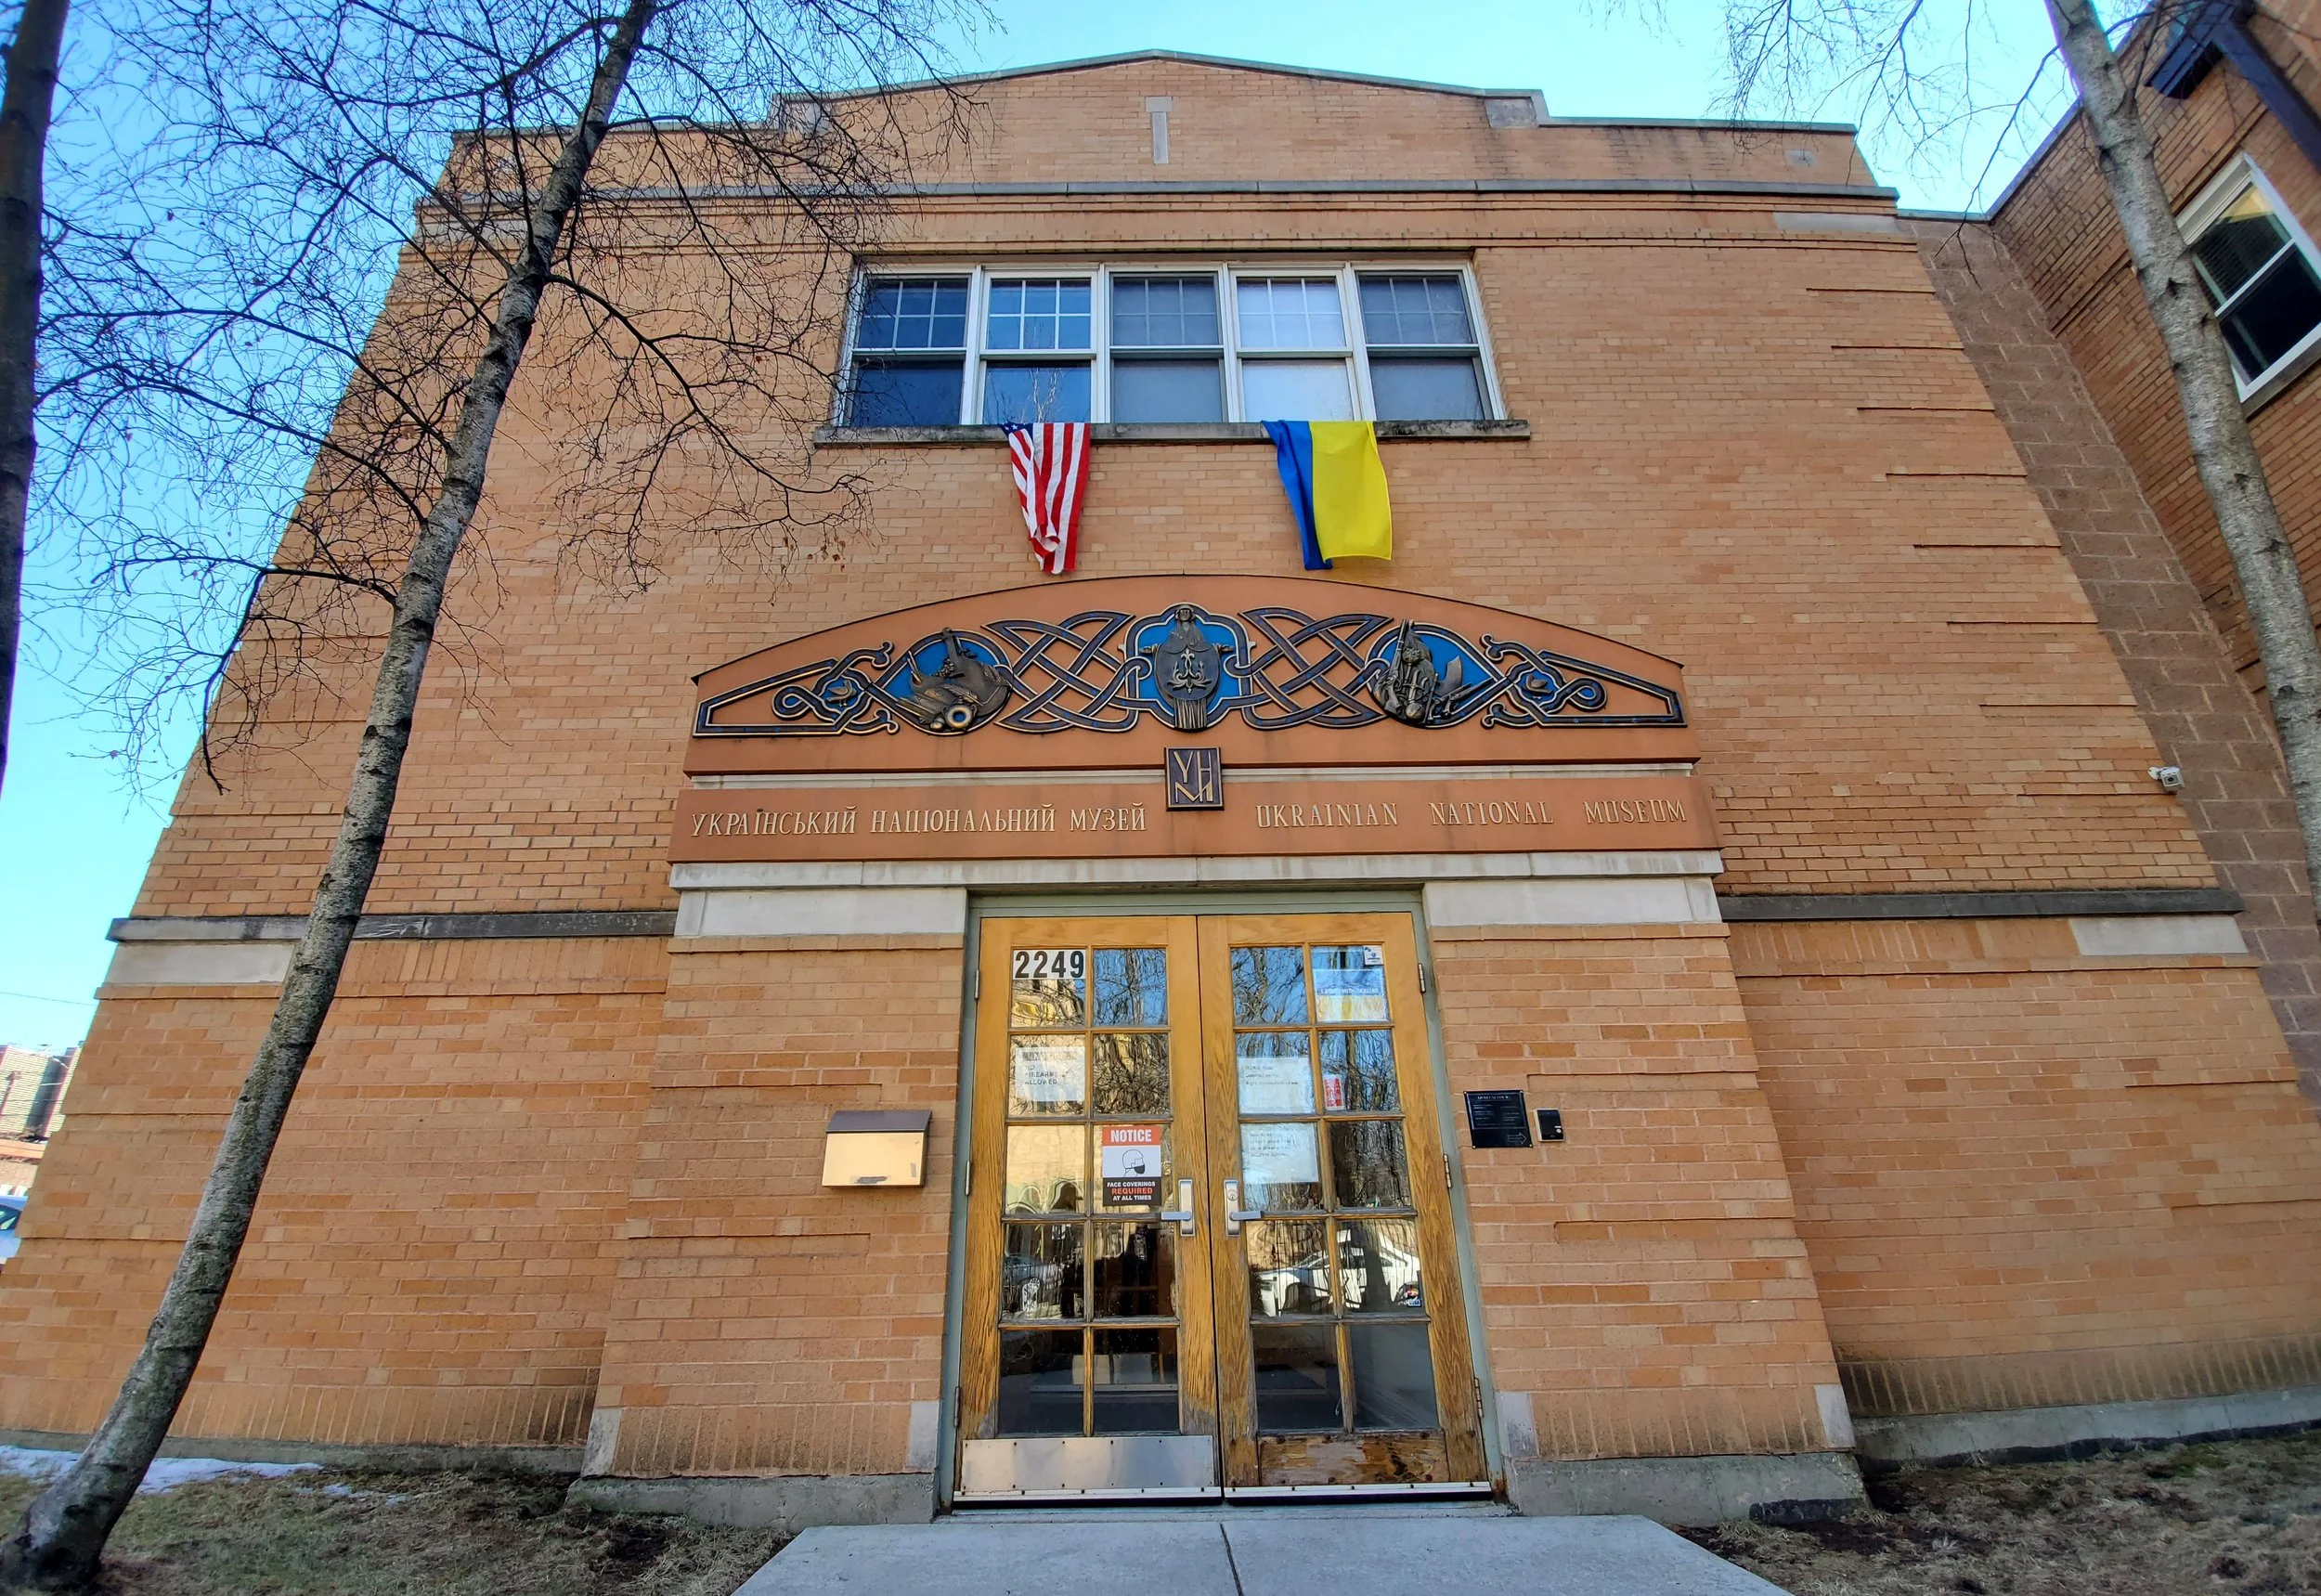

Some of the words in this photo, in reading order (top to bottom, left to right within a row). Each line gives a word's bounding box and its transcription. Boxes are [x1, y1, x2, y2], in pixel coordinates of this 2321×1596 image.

[691, 804, 858, 837] УКРАЇНСЬКИЙ
[869, 803, 1057, 835] НАЦІОНАЛЬНИЙ
[1070, 801, 1148, 833] МУЗЕЙ
[1255, 802, 1400, 829] UKRAINIAN
[1428, 800, 1554, 826] NATIONAL
[1583, 798, 1688, 825] MUSEUM
[1014, 950, 1085, 979] 2249
[1110, 1129, 1152, 1143] NOTICE
